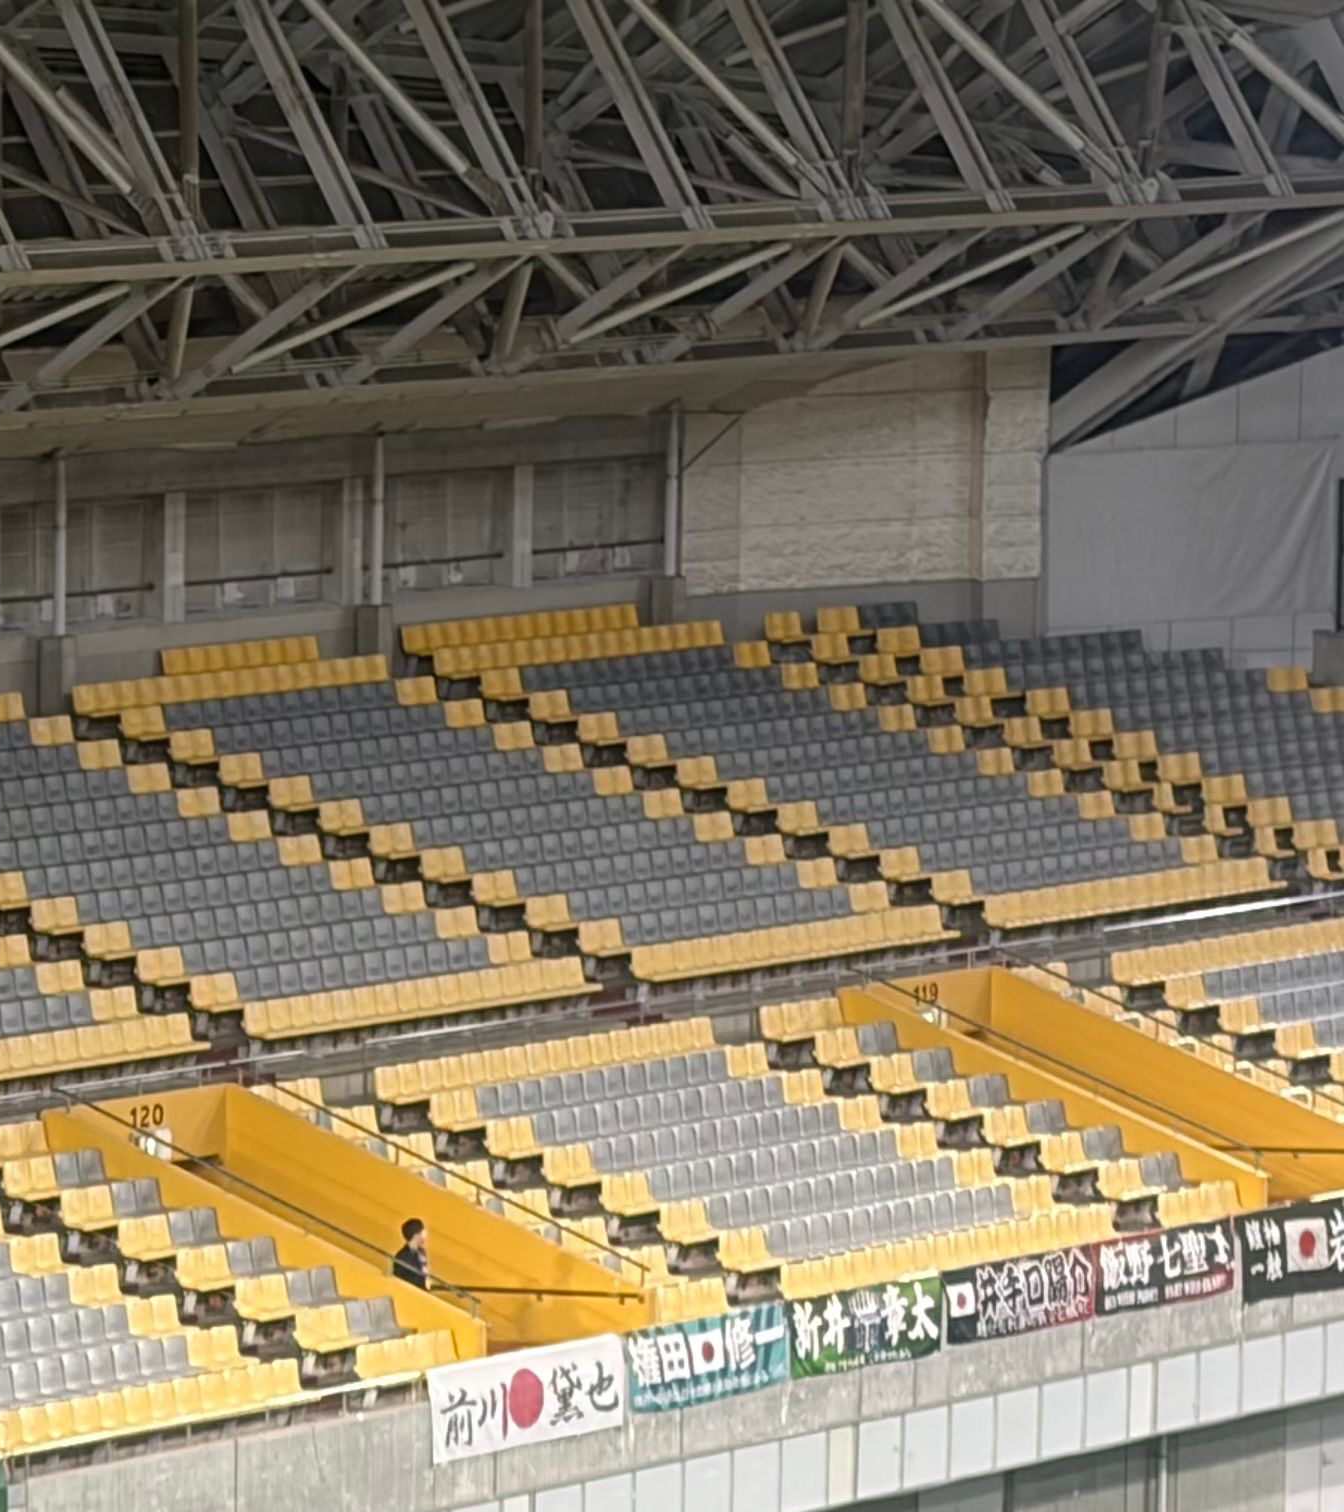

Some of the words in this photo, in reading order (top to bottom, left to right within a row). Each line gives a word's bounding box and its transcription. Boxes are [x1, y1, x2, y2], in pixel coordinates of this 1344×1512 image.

[913, 982, 939, 1007] 119
[130, 1103, 165, 1128] 120
[441, 1360, 619, 1448] 前川黛也
